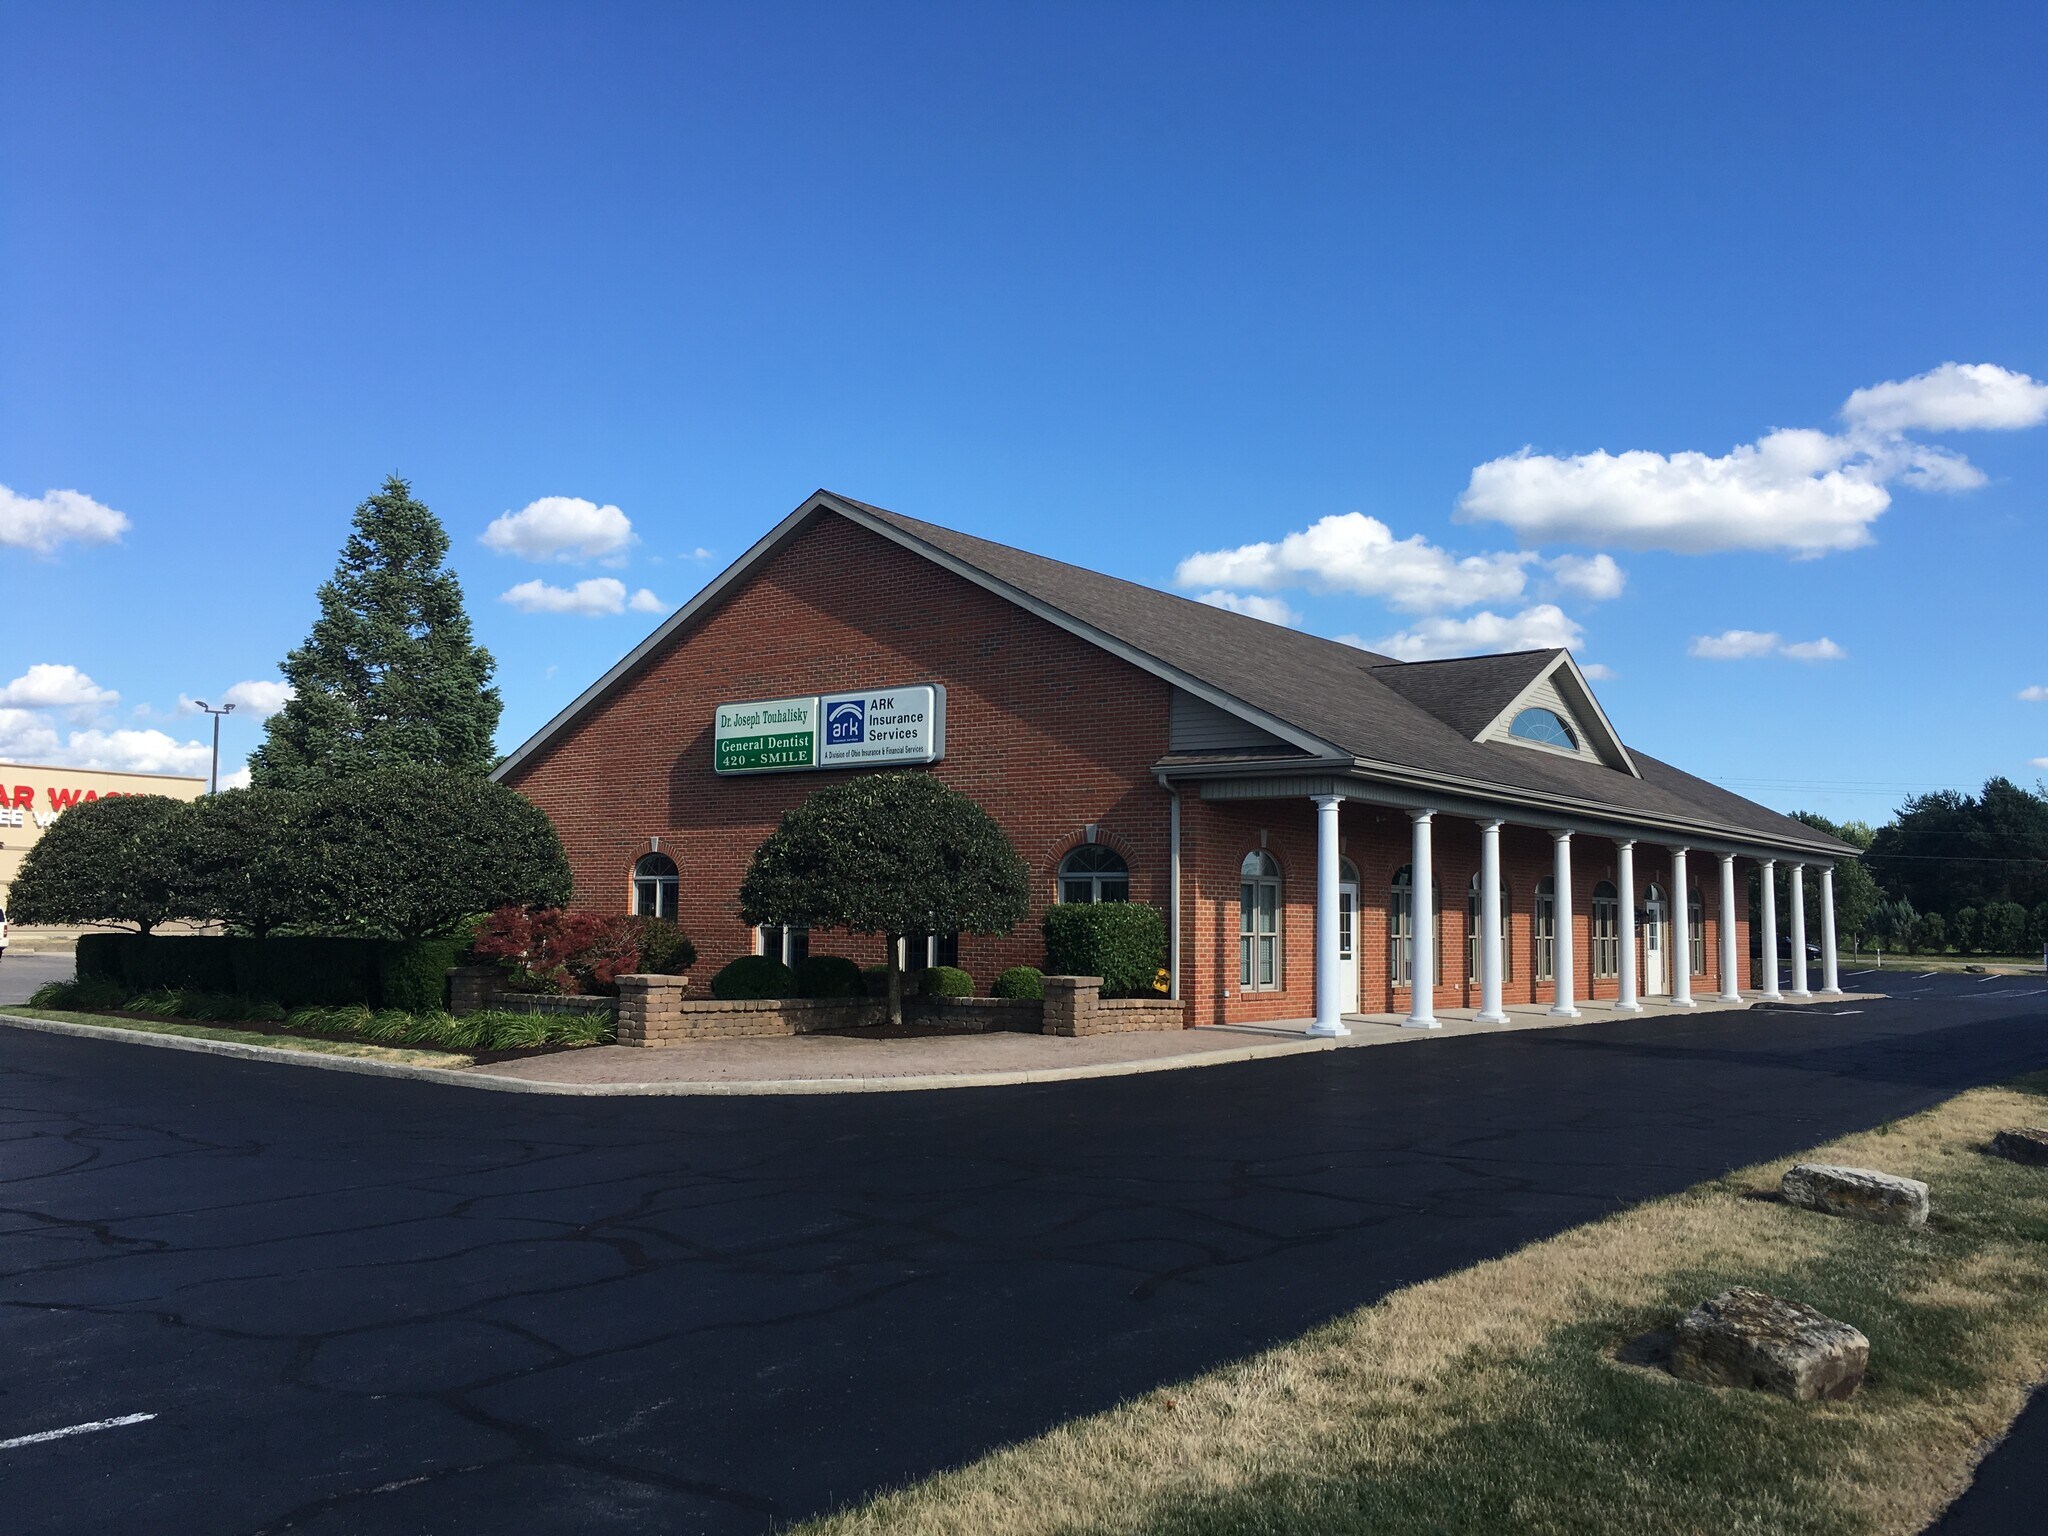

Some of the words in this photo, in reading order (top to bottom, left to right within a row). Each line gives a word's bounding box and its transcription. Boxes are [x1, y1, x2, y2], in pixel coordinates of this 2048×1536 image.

[870, 698, 895, 711] ARK
[721, 714, 732, 728] Dr.
[733, 712, 760, 729] Joseph
[763, 707, 808, 725] Touhalisky
[869, 713, 924, 726] Insurance
[832, 717, 859, 737] ark
[869, 728, 918, 742] Services
[721, 737, 764, 753] General
[768, 735, 809, 749] Dentist
[722, 755, 746, 767] 420
[760, 750, 808, 764] SMILE
[829, 750, 845, 759] Division
[845, 750, 851, 758] of
[861, 748, 881, 757] Insurance
[886, 746, 904, 755] Financial
[904, 745, 924, 754] Services
